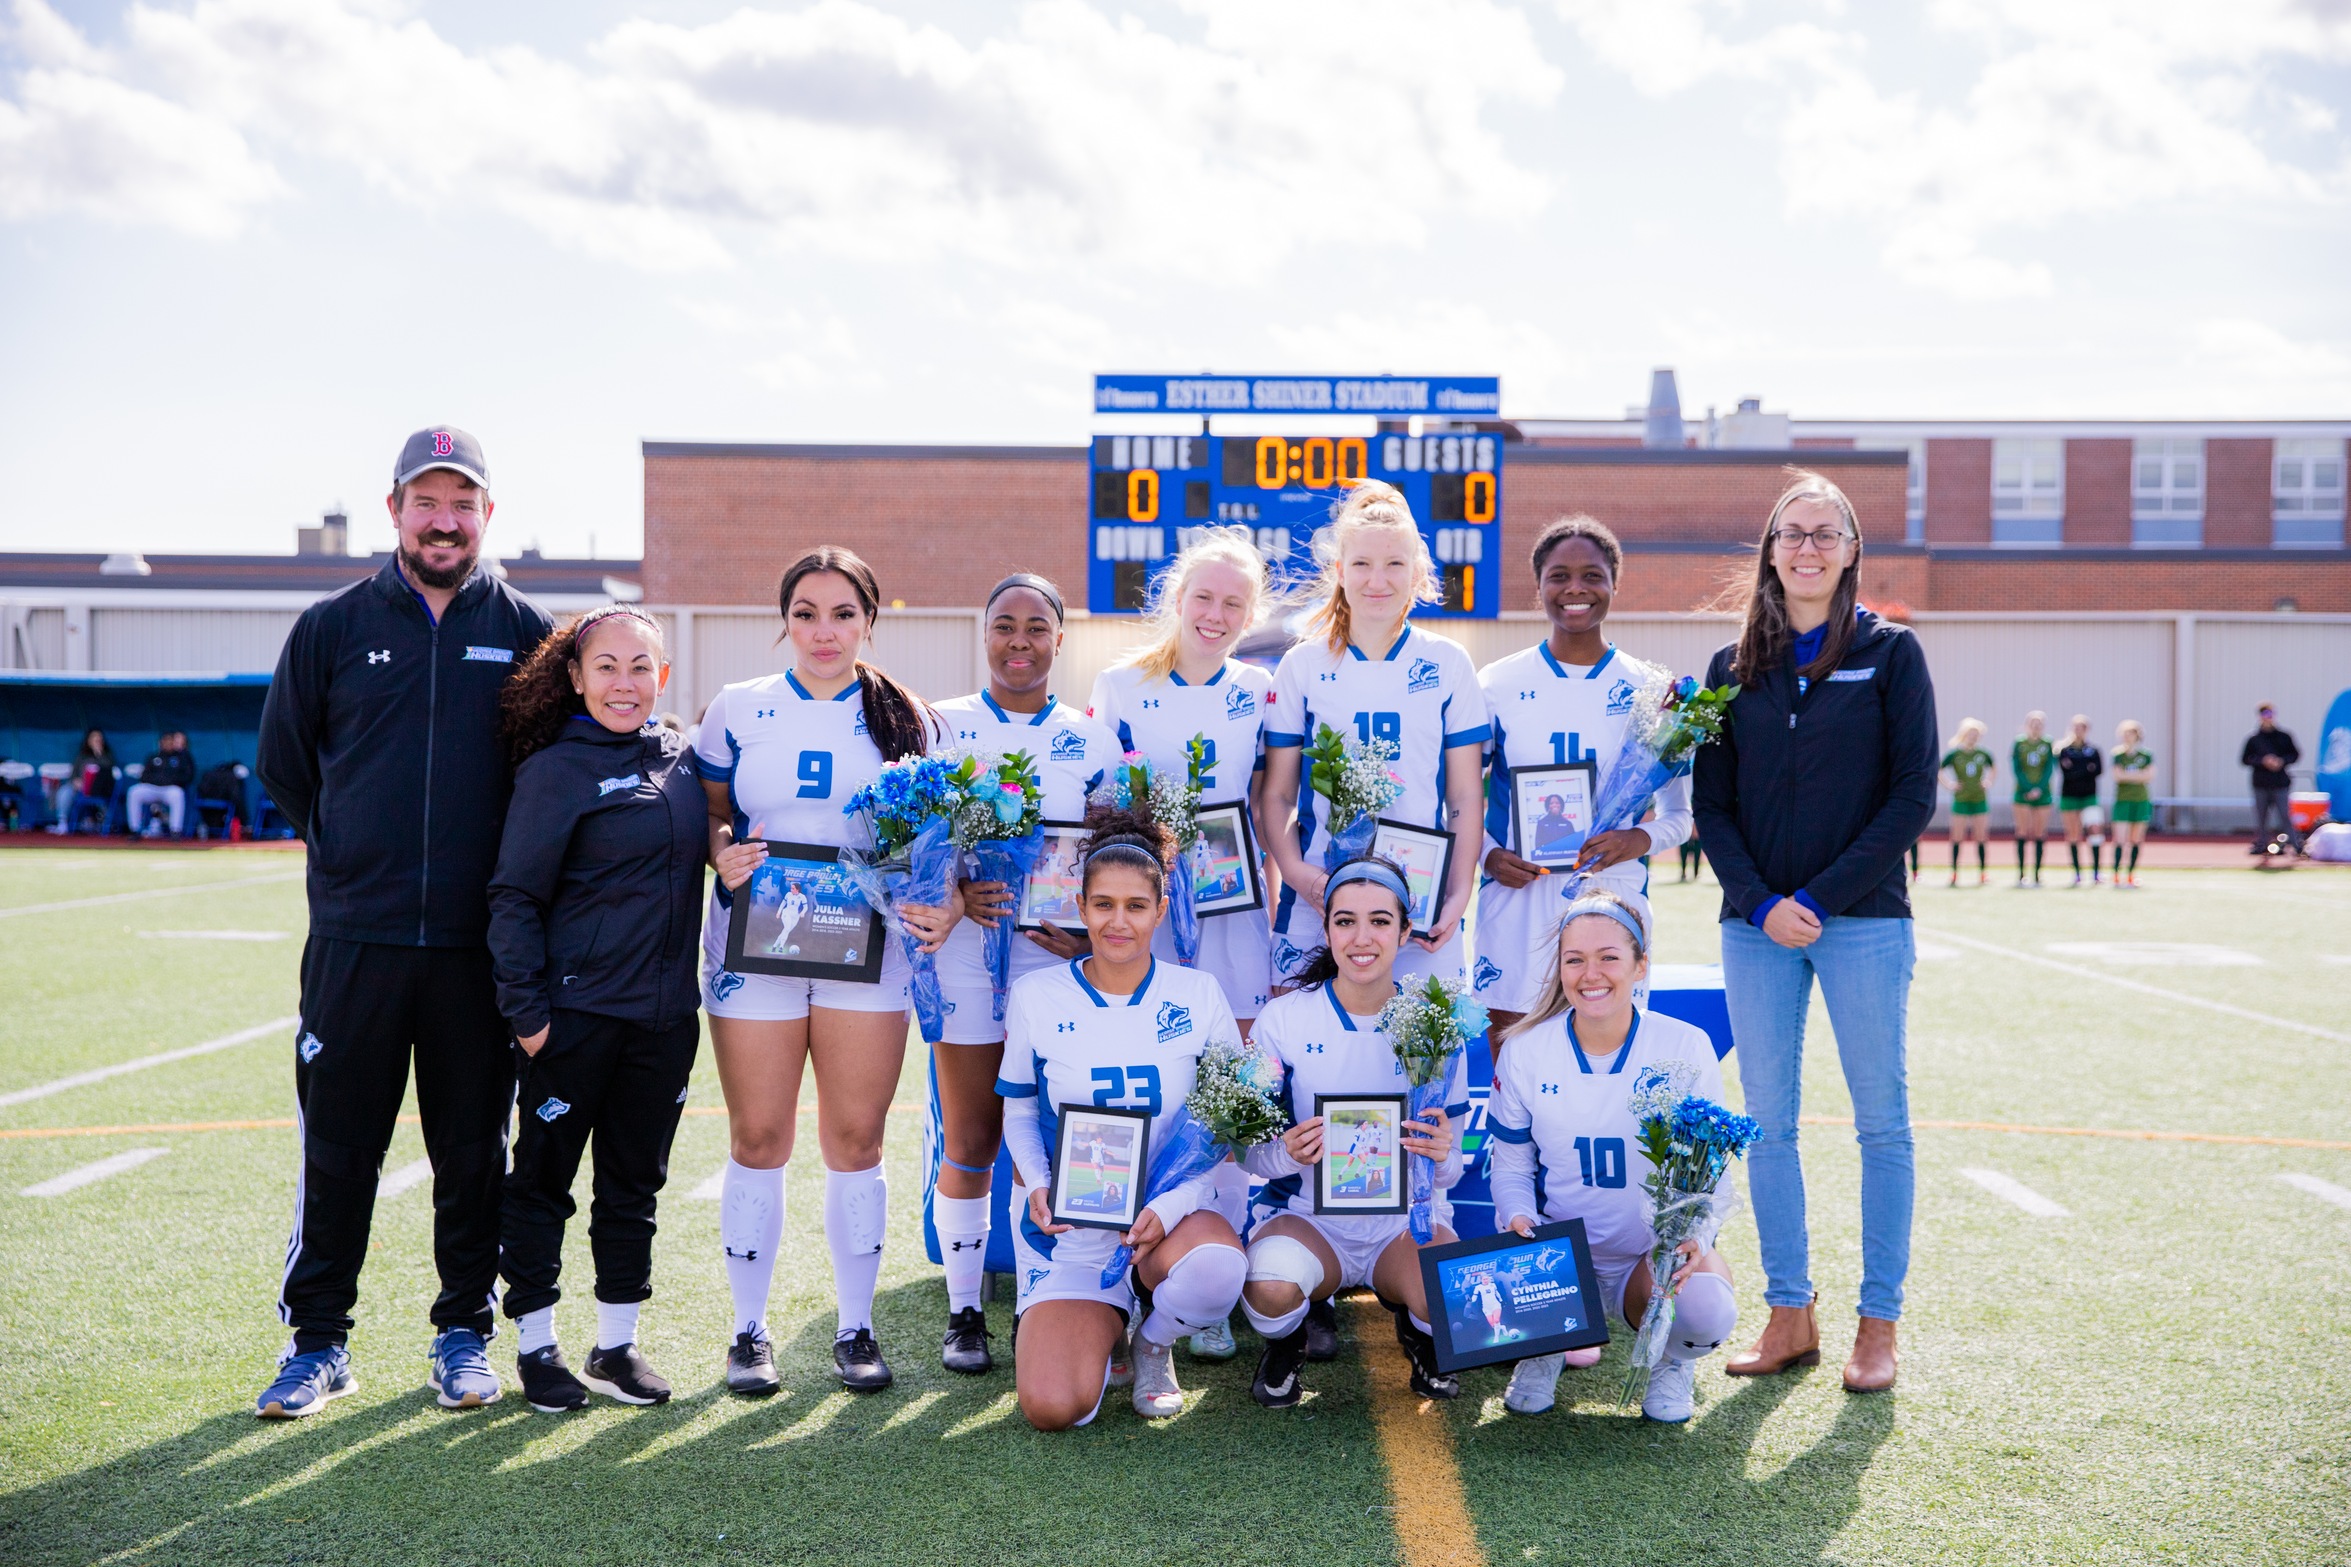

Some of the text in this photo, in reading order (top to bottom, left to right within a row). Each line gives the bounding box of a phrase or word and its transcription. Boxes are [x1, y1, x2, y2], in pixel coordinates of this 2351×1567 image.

[1334, 380, 1429, 411] STADIUM
[431, 431, 454, 457] B
[1112, 436, 1192, 471] HOME
[1383, 437, 1495, 473] GUESTS
[1256, 436, 1368, 490] 0:00
[1128, 469, 1160, 523] 0
[1464, 472, 1497, 524] 0
[1097, 526, 1164, 562] DOWN
[1436, 528, 1482, 563] QTR
[1462, 565, 1475, 612] 1
[1186, 739, 1216, 789] 2
[1549, 732, 1597, 764] 14
[796, 750, 833, 800] 9
[812, 914, 861, 927] KASSNER
[813, 904, 844, 915] JULIA
[1091, 1065, 1163, 1118] 23
[1573, 1136, 1627, 1189] 10
[1511, 1280, 1559, 1296] CYNTHIA
[1513, 1285, 1579, 1305] PELLEGRINO
